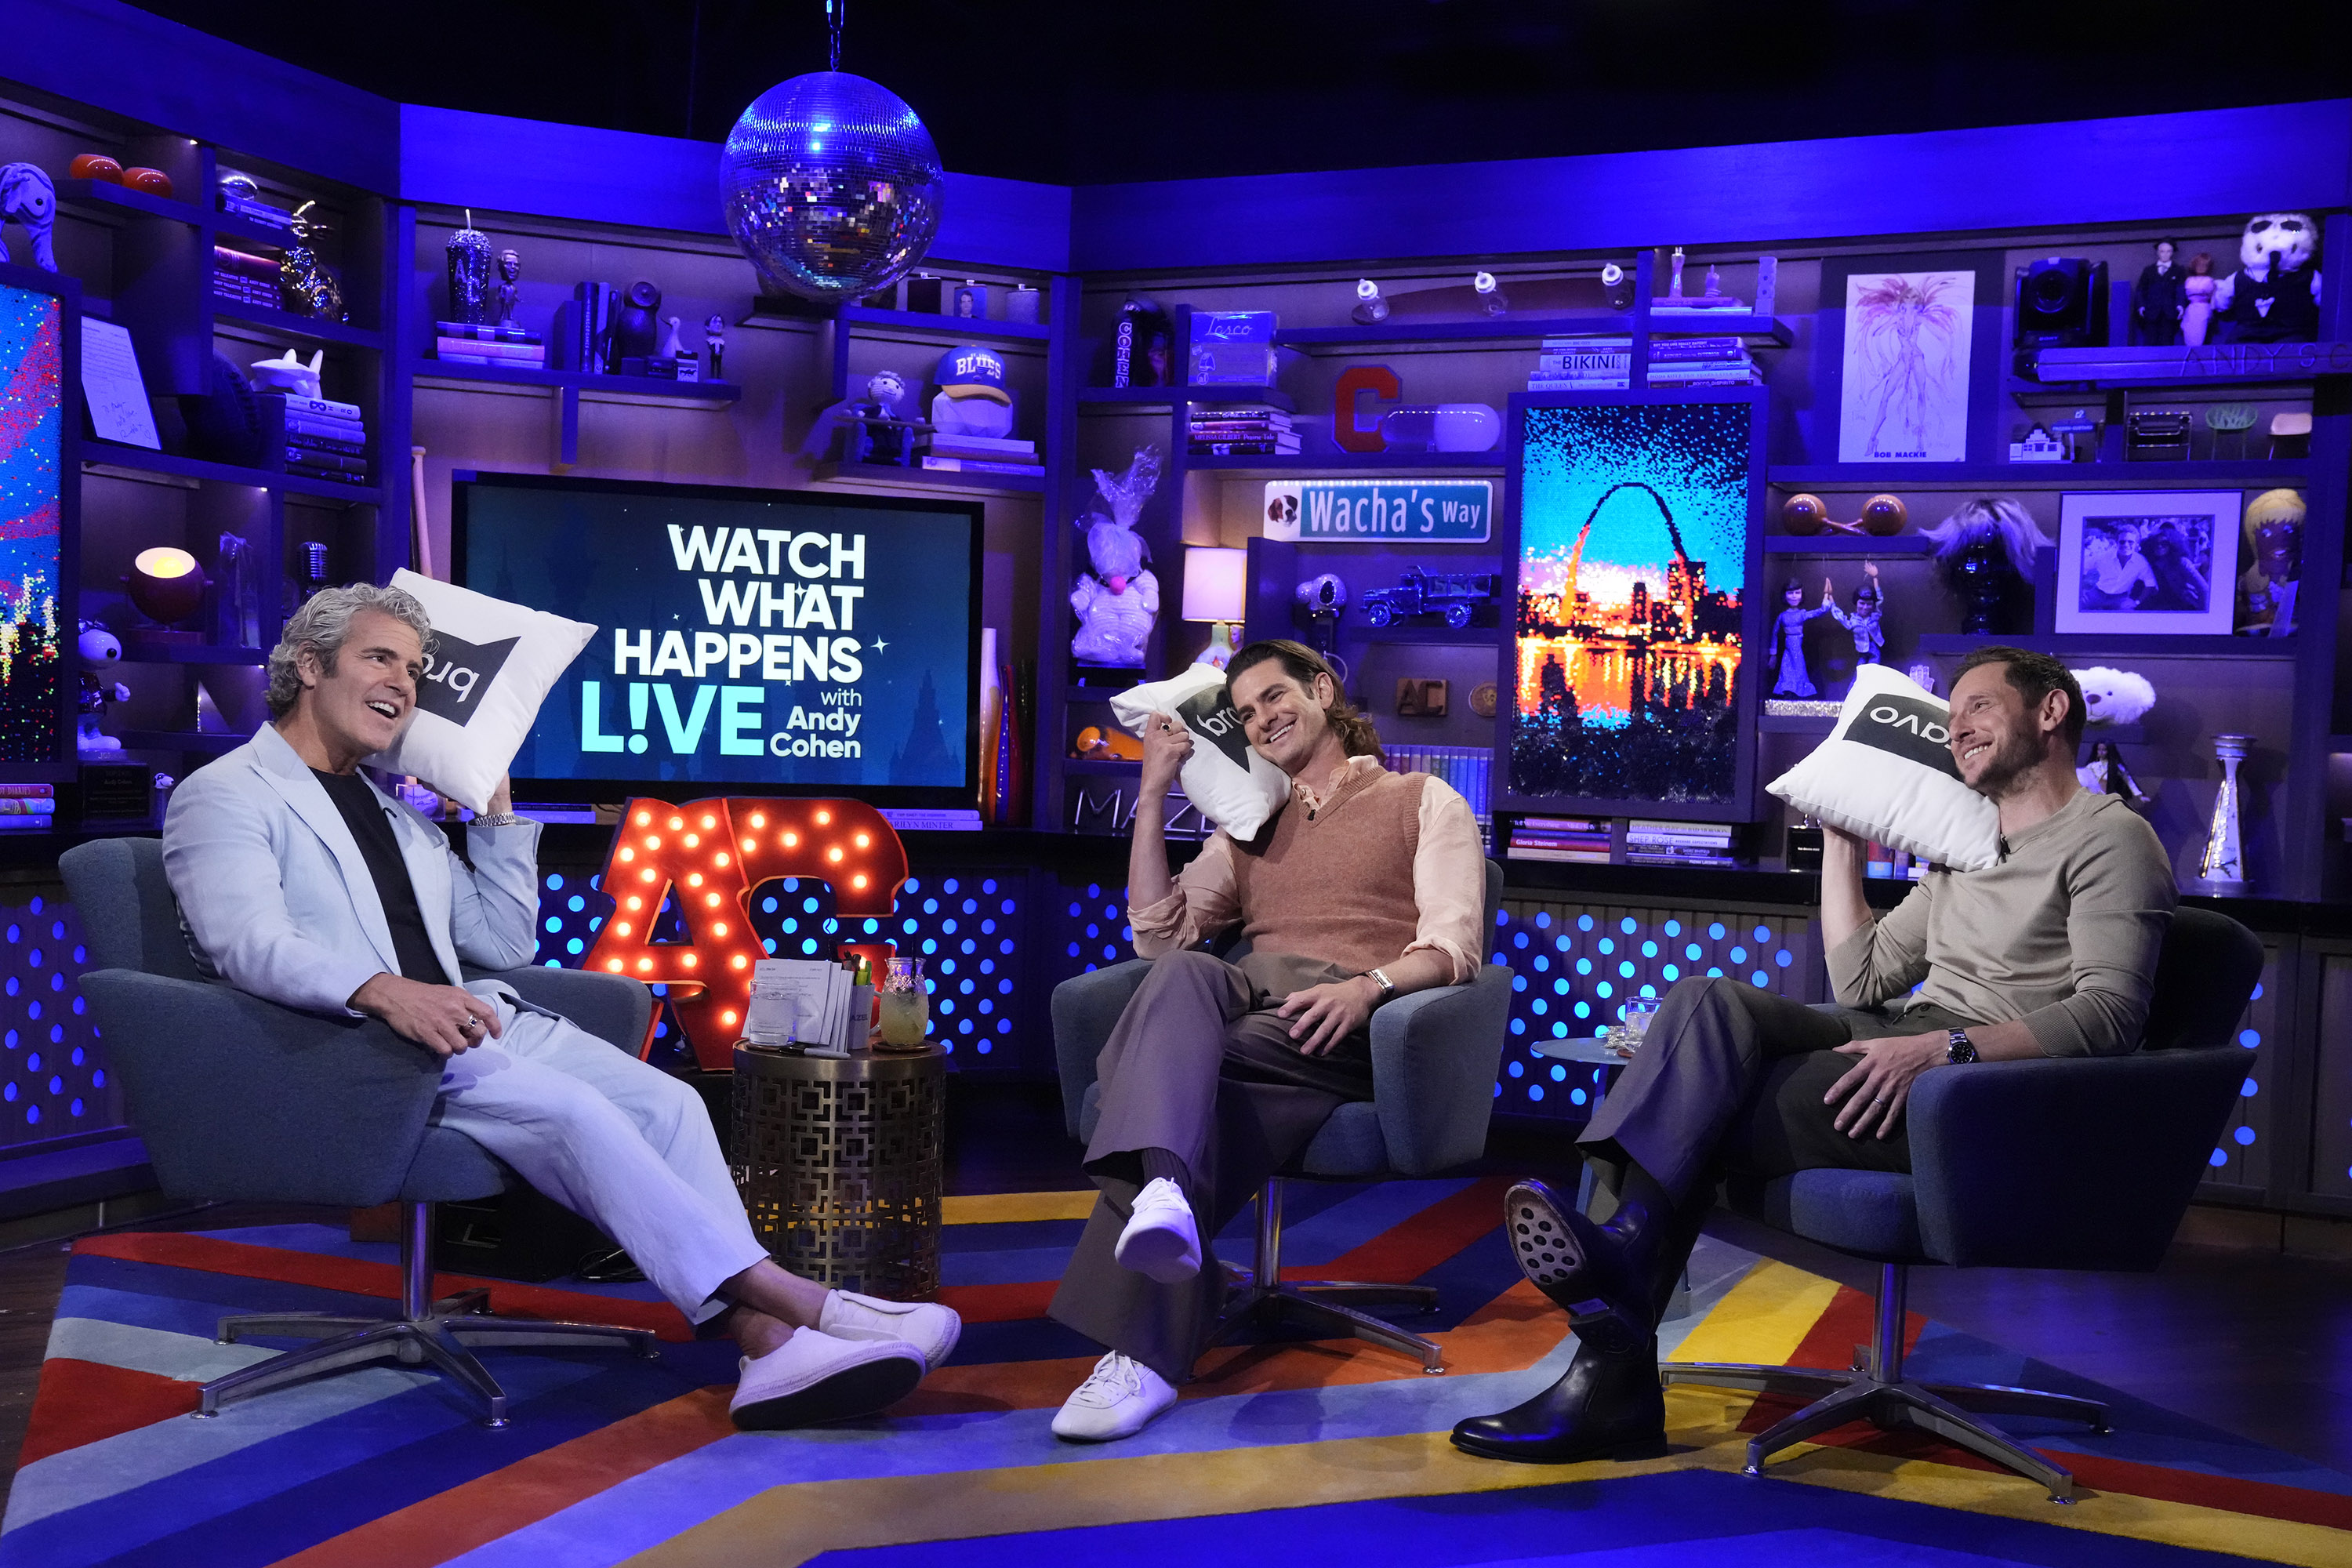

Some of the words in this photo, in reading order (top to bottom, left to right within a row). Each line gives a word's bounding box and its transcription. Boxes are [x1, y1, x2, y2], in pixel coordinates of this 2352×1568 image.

[956, 357, 1000, 380] BLUES
[1116, 322, 1132, 388] COHEN
[1563, 355, 1615, 370] BIKINI
[1309, 488, 1434, 534] Wacha's
[1443, 500, 1481, 530] Way
[666, 524, 865, 579] WATCH
[698, 578, 864, 630] WHAT
[615, 628, 862, 683] HAPPENS
[820, 687, 862, 706] with
[1398, 680, 1443, 716] AC
[582, 681, 764, 756] L!VE
[786, 706, 861, 737] Andy
[770, 731, 861, 758] Cohen
[1629, 835, 1649, 844] SHEP
[1652, 836, 1674, 844] ROSE
